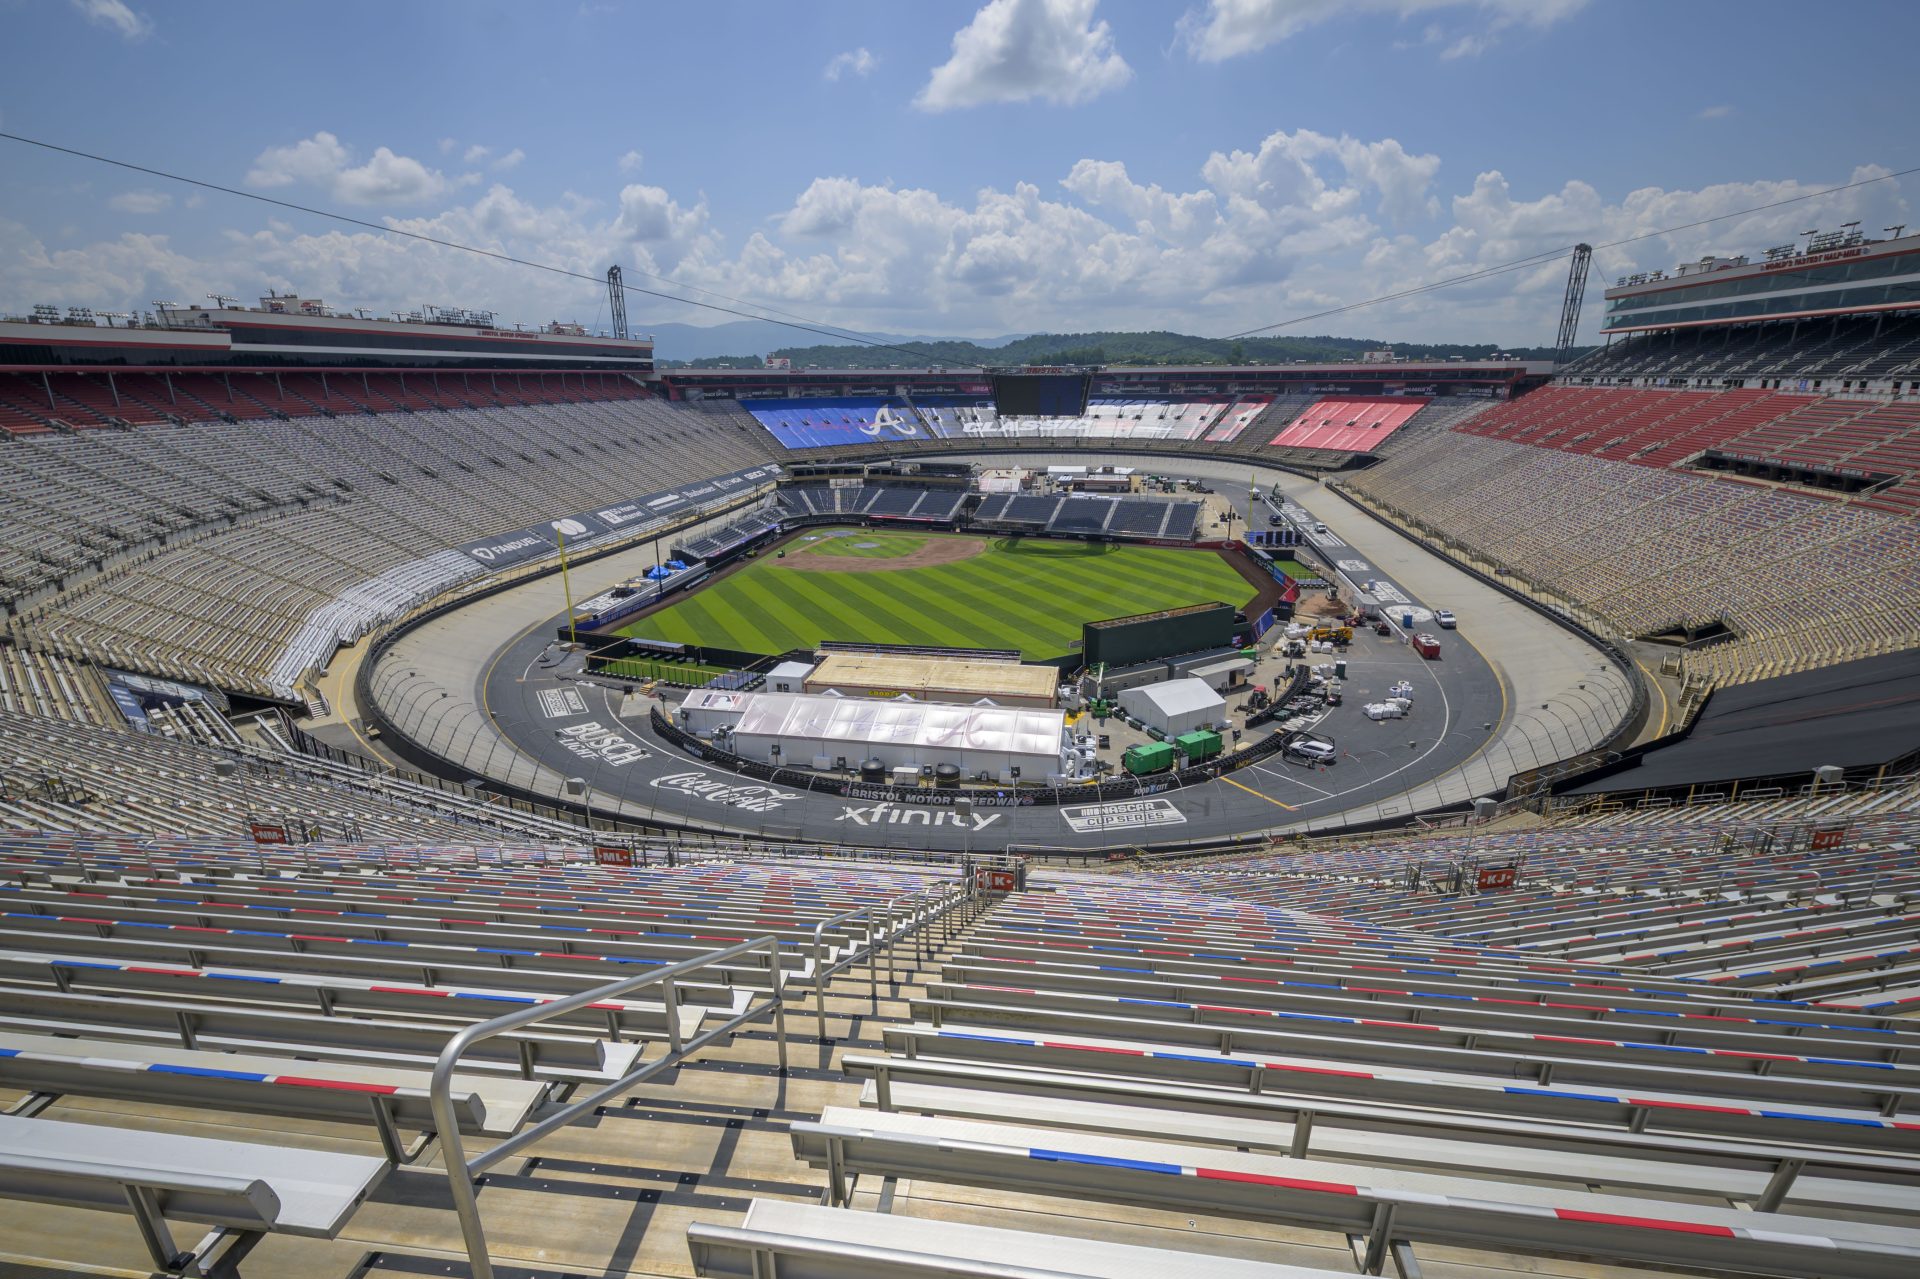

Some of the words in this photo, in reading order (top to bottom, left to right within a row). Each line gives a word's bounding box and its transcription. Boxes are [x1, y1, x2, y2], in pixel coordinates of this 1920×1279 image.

[962, 419, 1089, 432] CLASSIC
[490, 536, 542, 555] FANDUEL
[559, 737, 600, 760] LIGHT
[560, 722, 652, 766] BUSCH
[650, 772, 805, 812] Coca-Cola
[851, 788, 901, 801] BRISTOL
[905, 794, 950, 805] MOTOR
[953, 796, 1023, 806] EEDWAY
[1134, 786, 1150, 796] FOOD
[1156, 783, 1169, 791] CITY
[1101, 802, 1155, 814] NASCAR
[834, 802, 1001, 831] xfinity
[1087, 816, 1115, 826] CUP
[1117, 812, 1165, 823] SERIES
[603, 852, 623, 862] ML
[1487, 873, 1507, 884] KJ
